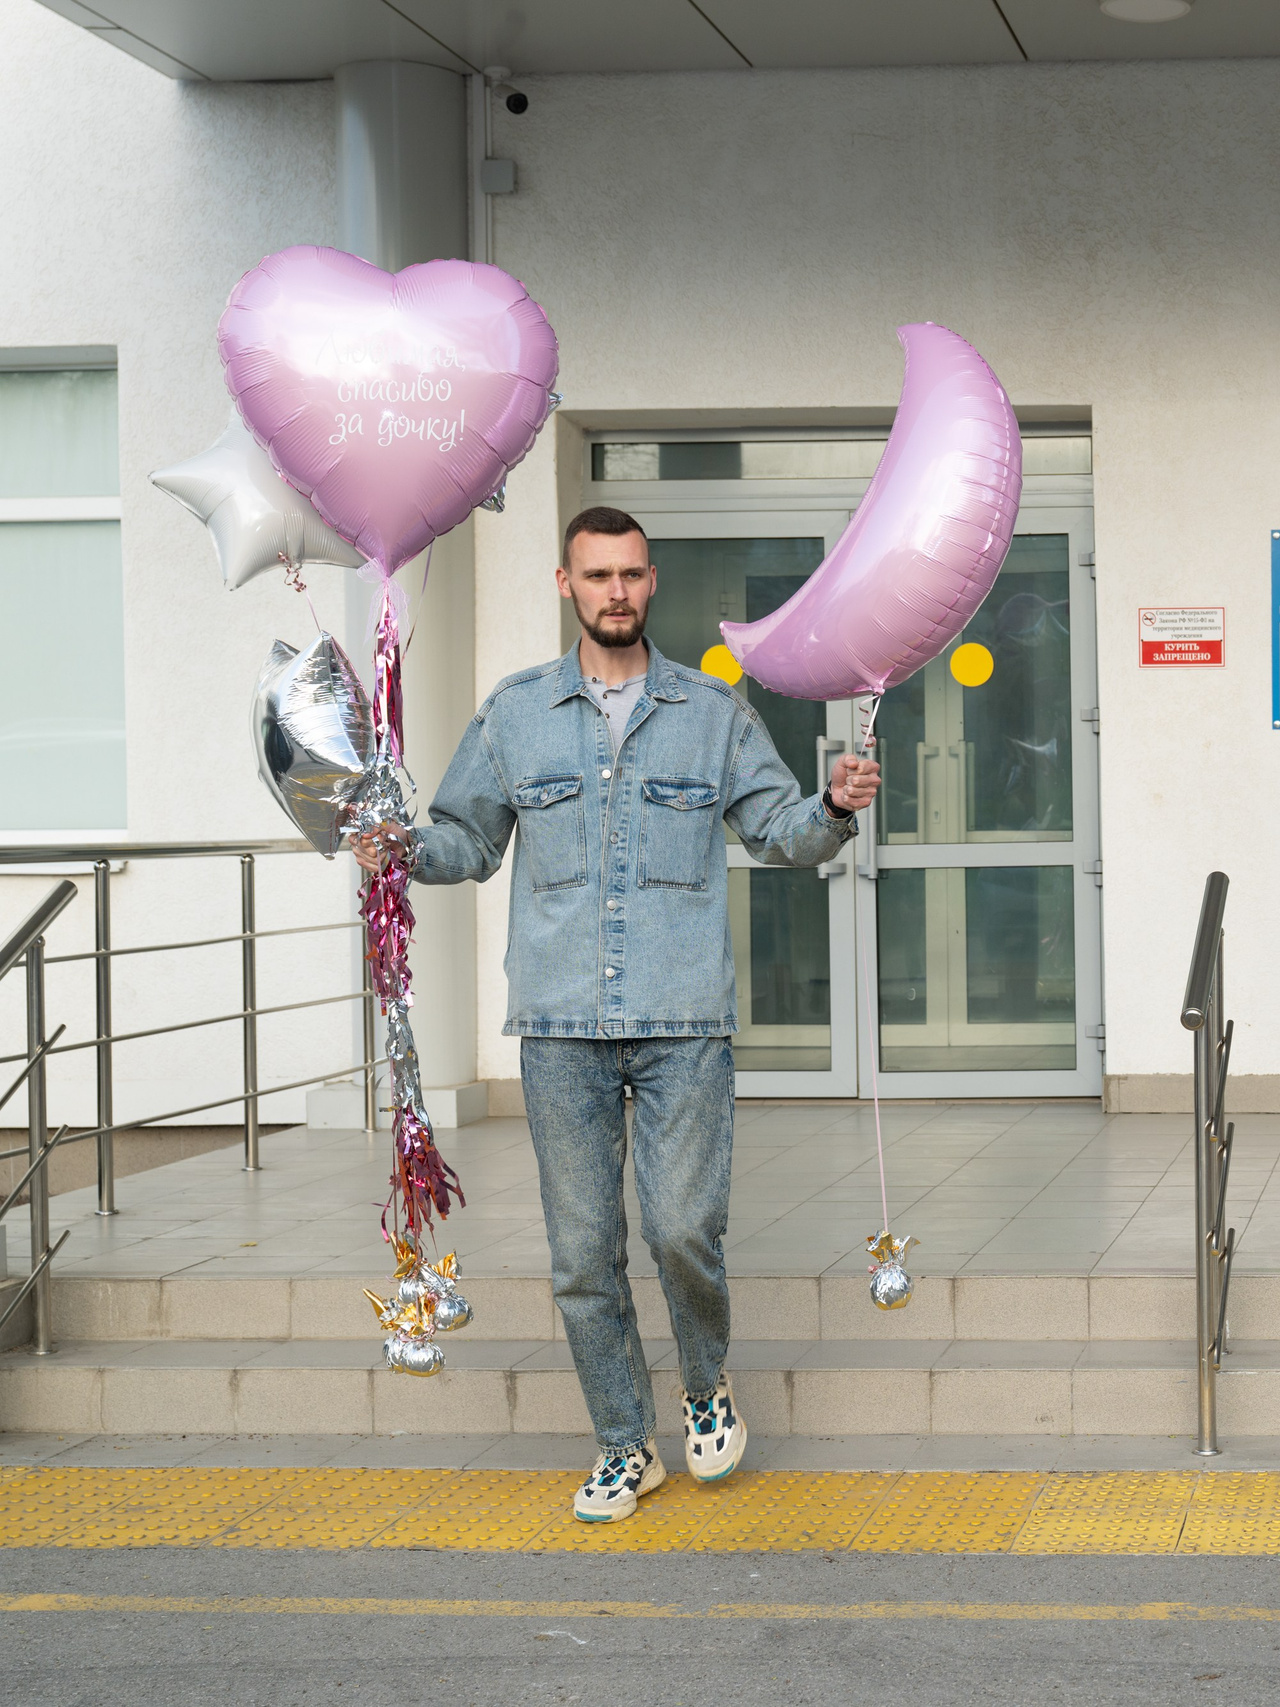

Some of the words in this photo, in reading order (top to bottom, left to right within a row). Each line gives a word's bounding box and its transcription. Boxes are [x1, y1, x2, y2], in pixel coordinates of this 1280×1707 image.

[337, 371, 452, 402] спасибо
[328, 413, 364, 446] за
[377, 409, 466, 452] дочку!
[1153, 653, 1211, 661] ЗАПРЕЩЕНО
